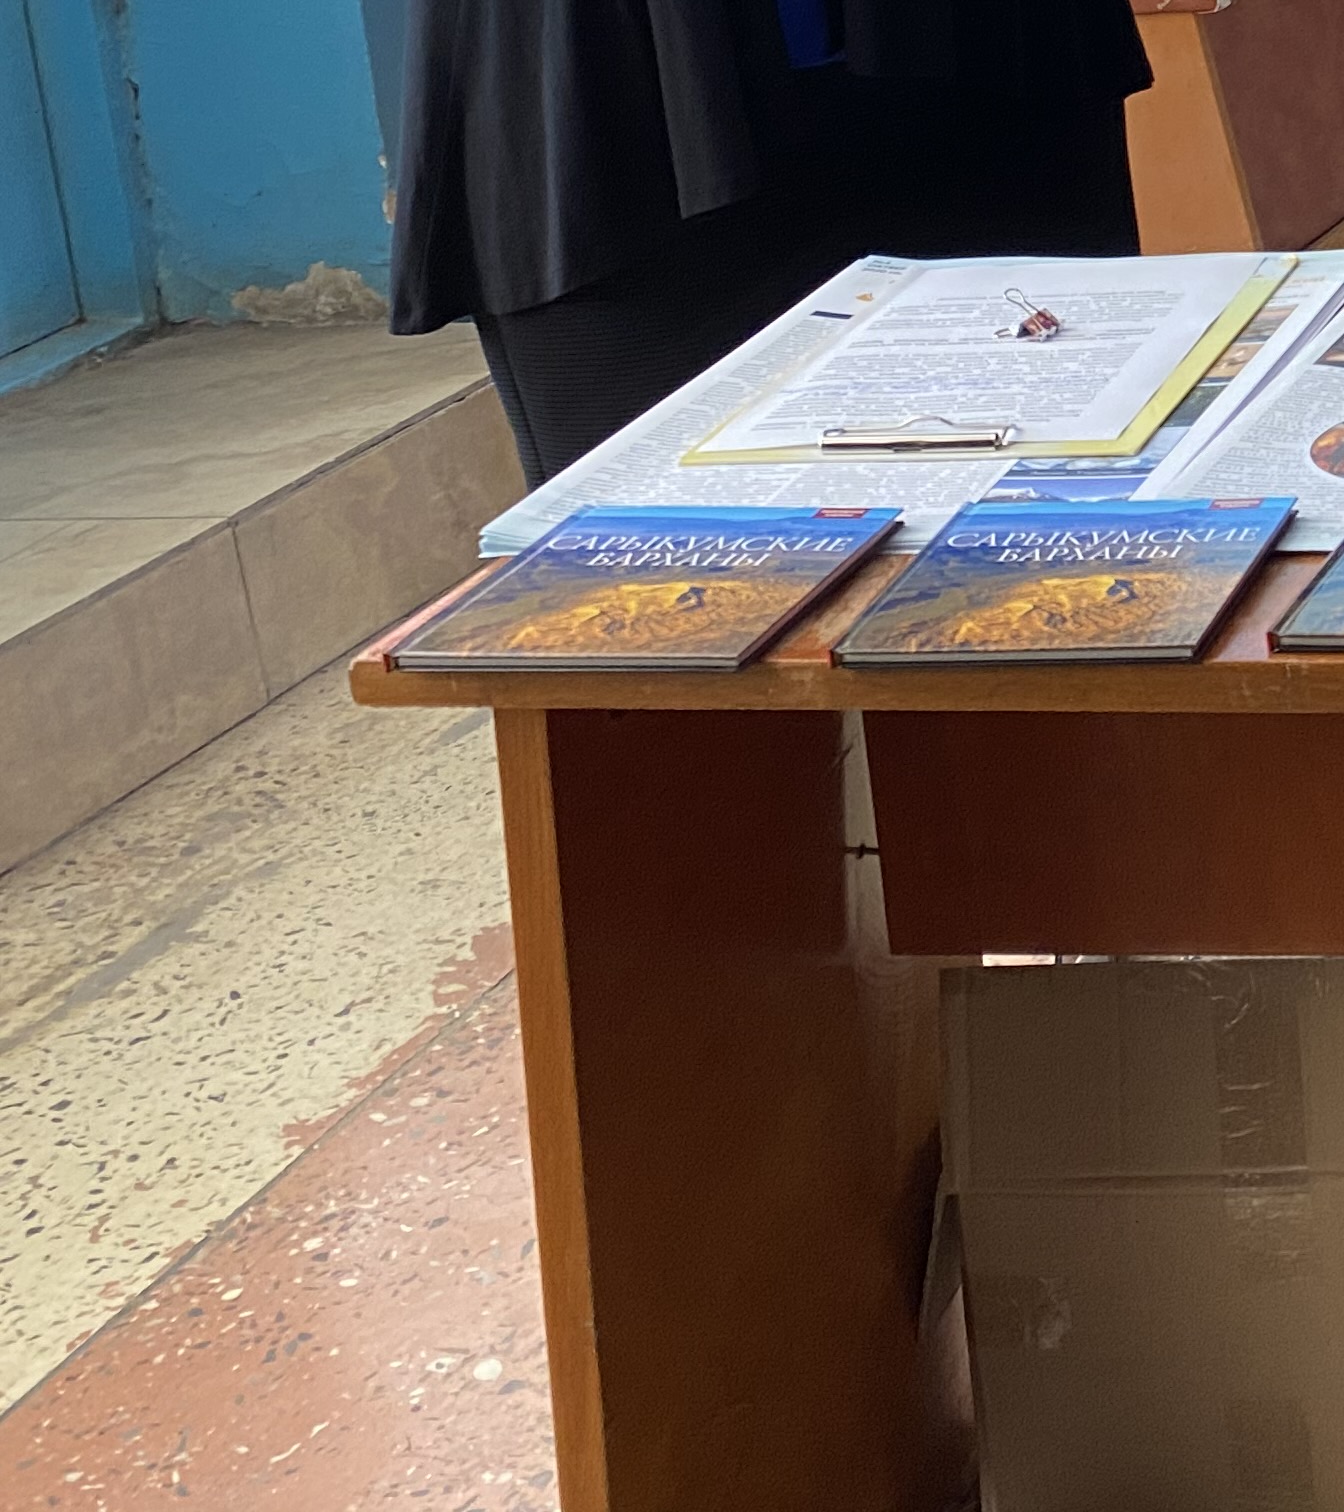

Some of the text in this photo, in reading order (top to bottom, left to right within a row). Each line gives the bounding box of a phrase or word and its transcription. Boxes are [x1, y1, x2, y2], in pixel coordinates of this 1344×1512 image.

[547, 536, 854, 552] САРЫКУМСКИЕ
[946, 527, 1260, 550] САРЫКУМСКИЕ
[586, 552, 772, 567] БАРХАНЫ
[997, 545, 1183, 563] БАРХАНЫ
